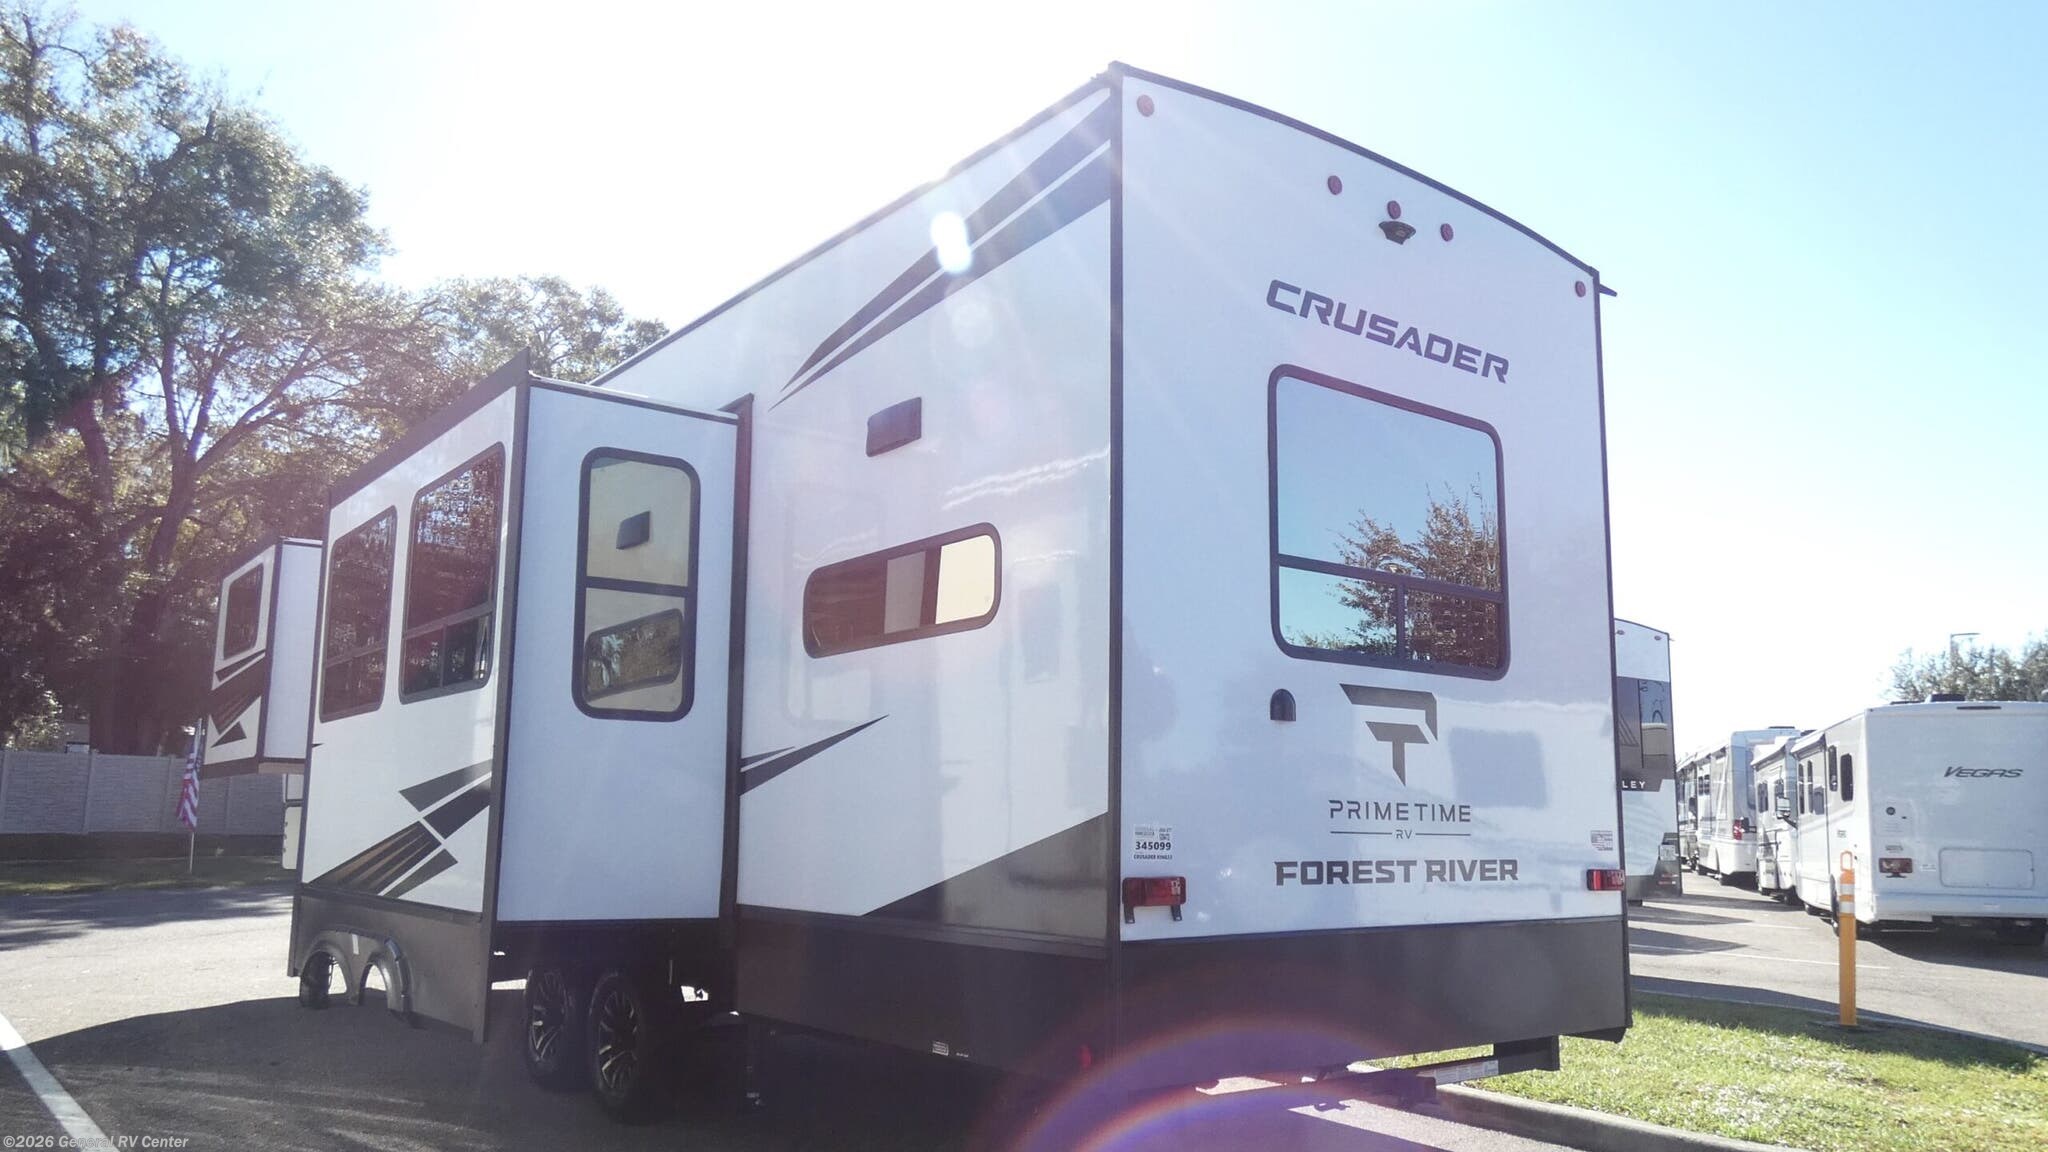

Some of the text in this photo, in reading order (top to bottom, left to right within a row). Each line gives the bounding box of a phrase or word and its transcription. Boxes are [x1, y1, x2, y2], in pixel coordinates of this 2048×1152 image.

[1266, 279, 1510, 384] CRUSADER
[1943, 765, 2024, 778] VEGAS
[1622, 780, 1646, 789] LEY
[1395, 829, 1413, 840] RV
[1135, 841, 1172, 851] 345099
[1274, 859, 1519, 886] FOREST RIVER
